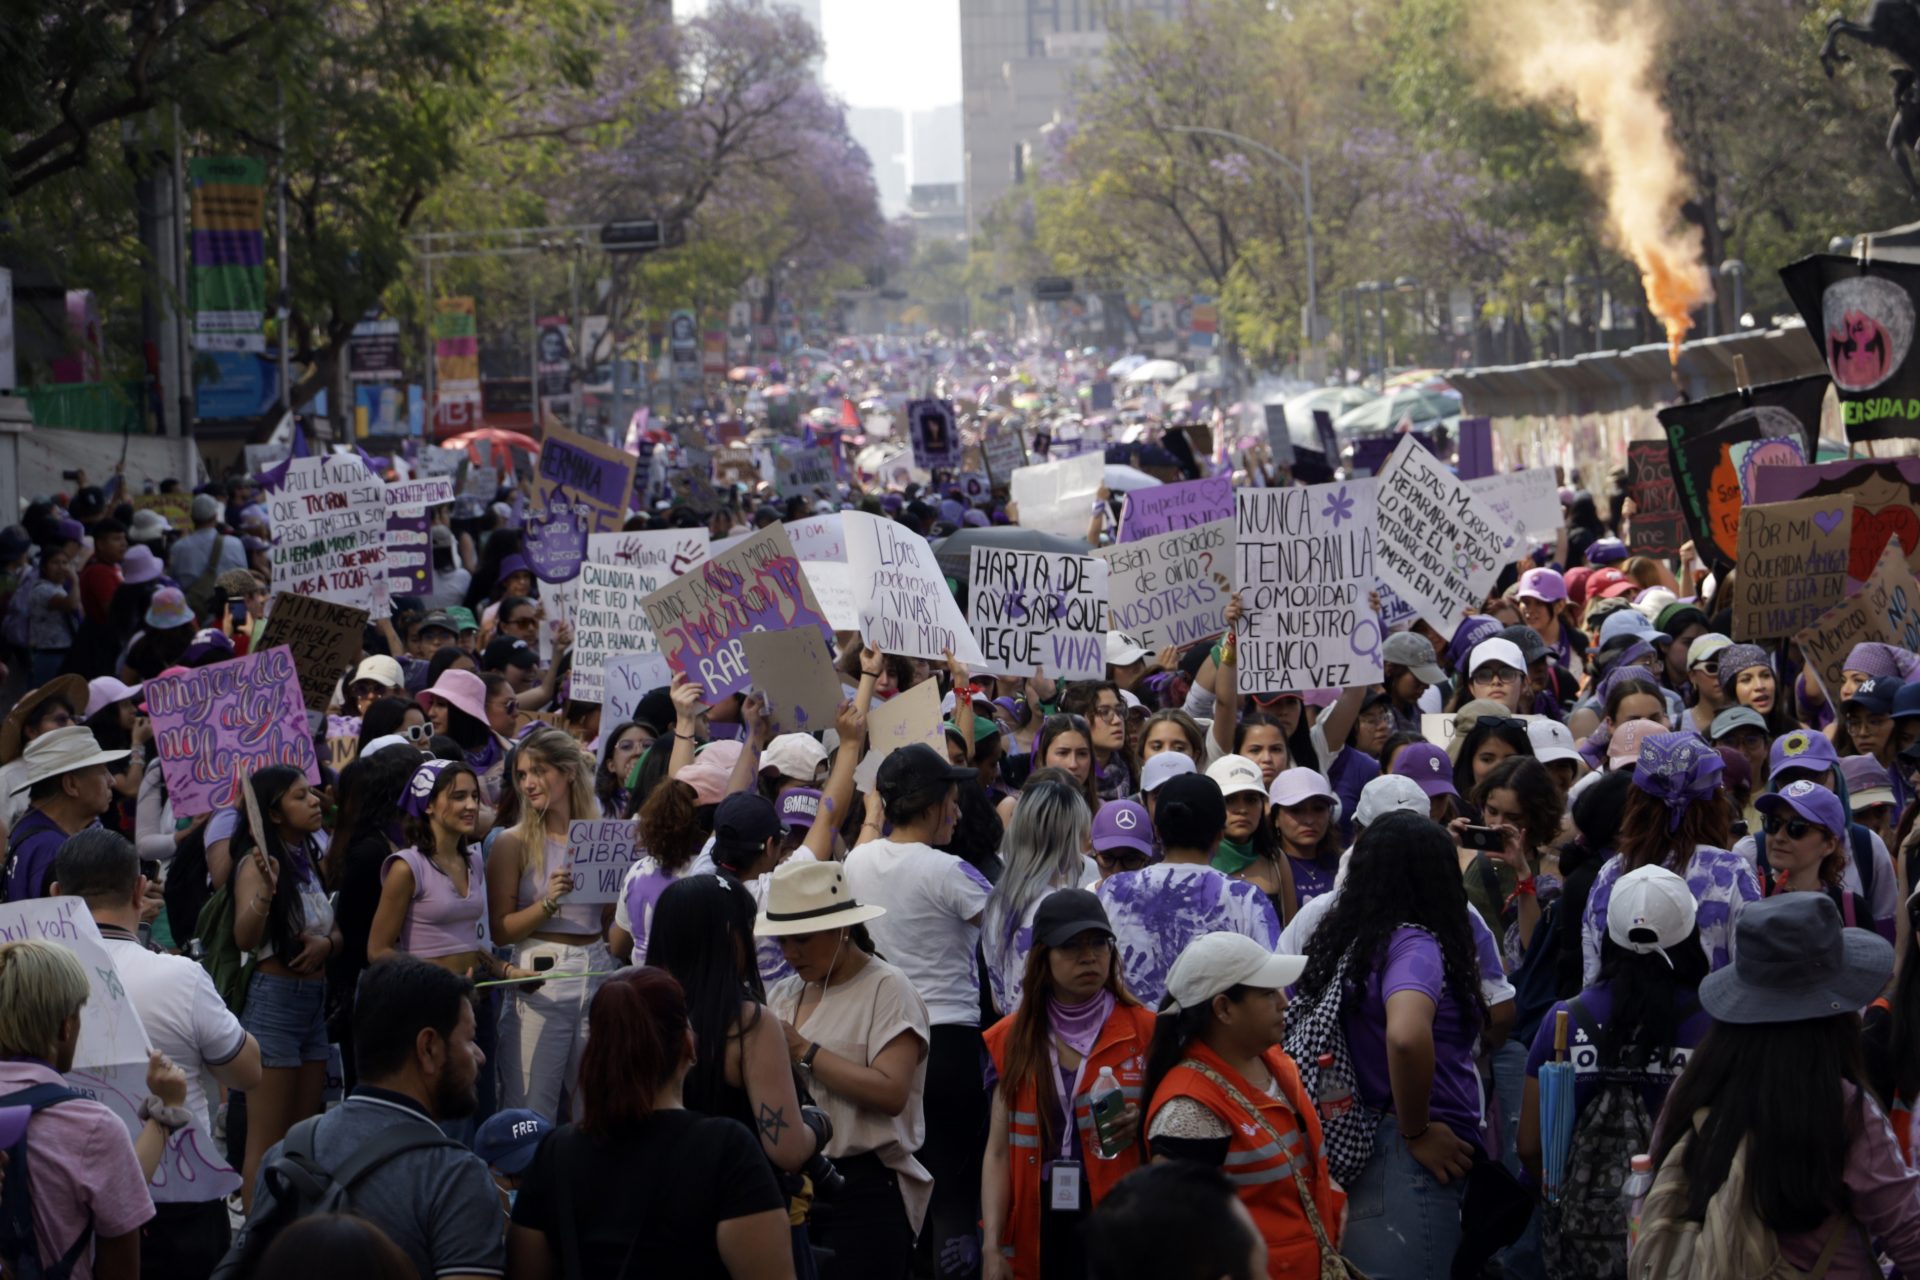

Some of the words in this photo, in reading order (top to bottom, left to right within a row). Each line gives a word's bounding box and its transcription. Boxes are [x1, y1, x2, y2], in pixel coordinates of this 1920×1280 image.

[313, 464, 330, 489] LA
[273, 501, 299, 521] QUE
[301, 491, 349, 514] TOCARON
[352, 487, 380, 504] SIN
[1239, 489, 1311, 536] NUNCA
[1377, 485, 1398, 512] LO
[1427, 531, 1442, 556] EL
[1389, 470, 1459, 542] REPARARON
[1463, 531, 1495, 571] TODO
[274, 548, 287, 564] LA
[360, 529, 378, 545] DE
[1158, 526, 1225, 561] cansados
[1788, 517, 1811, 543] MI
[327, 554, 336, 569] LA
[976, 550, 1048, 591] HARTA
[1058, 556, 1095, 593] DE
[1237, 531, 1343, 583] TENDRÁN
[1351, 527, 1372, 578] LA
[317, 576, 329, 592] A
[583, 565, 636, 591] CALLADITA
[639, 576, 656, 591] NO
[1746, 582, 1779, 605] QUE
[1823, 576, 1843, 598] EN
[582, 589, 601, 605] ME
[648, 590, 691, 629] DONDE
[977, 590, 1060, 628] AVISAR
[1066, 598, 1108, 634] QUE
[1112, 579, 1216, 630] NOSOTRAS
[1415, 574, 1434, 597] EN
[1433, 590, 1456, 619] MI
[578, 609, 621, 629] BONITA
[1236, 612, 1263, 638] DE
[1277, 610, 1356, 637] NUESTRO
[577, 630, 604, 649] BATA
[608, 632, 646, 650] BLANCA
[864, 616, 874, 643] Y
[878, 616, 904, 650] SIN
[918, 624, 956, 657] MIEDO
[1052, 633, 1102, 672] VIVA
[1240, 670, 1293, 691] OTRA
[1309, 664, 1350, 688] VEZ
[512, 1120, 538, 1140] FRET
